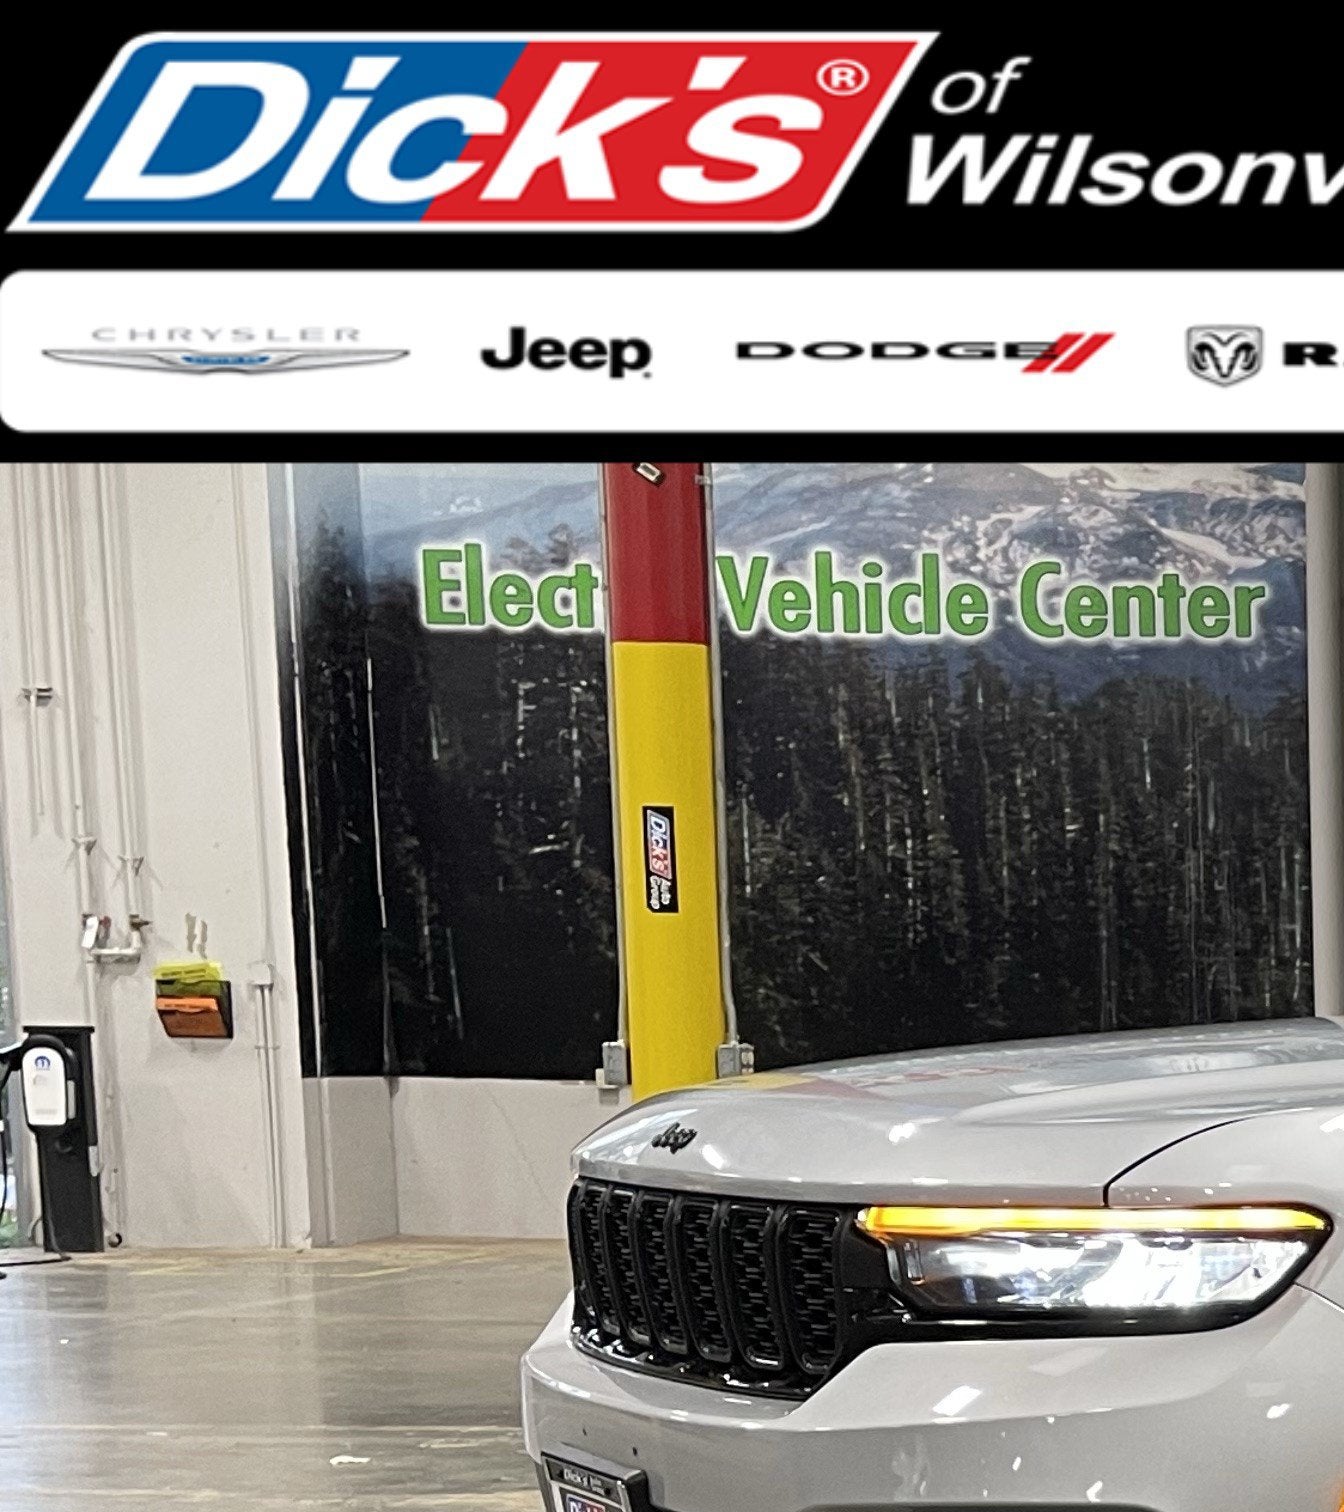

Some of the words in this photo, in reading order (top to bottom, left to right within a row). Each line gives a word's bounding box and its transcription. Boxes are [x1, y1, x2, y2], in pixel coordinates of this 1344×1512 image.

[422, 543, 598, 630] Elect
[716, 550, 990, 637] Vehicle
[1020, 560, 1267, 640] Center
